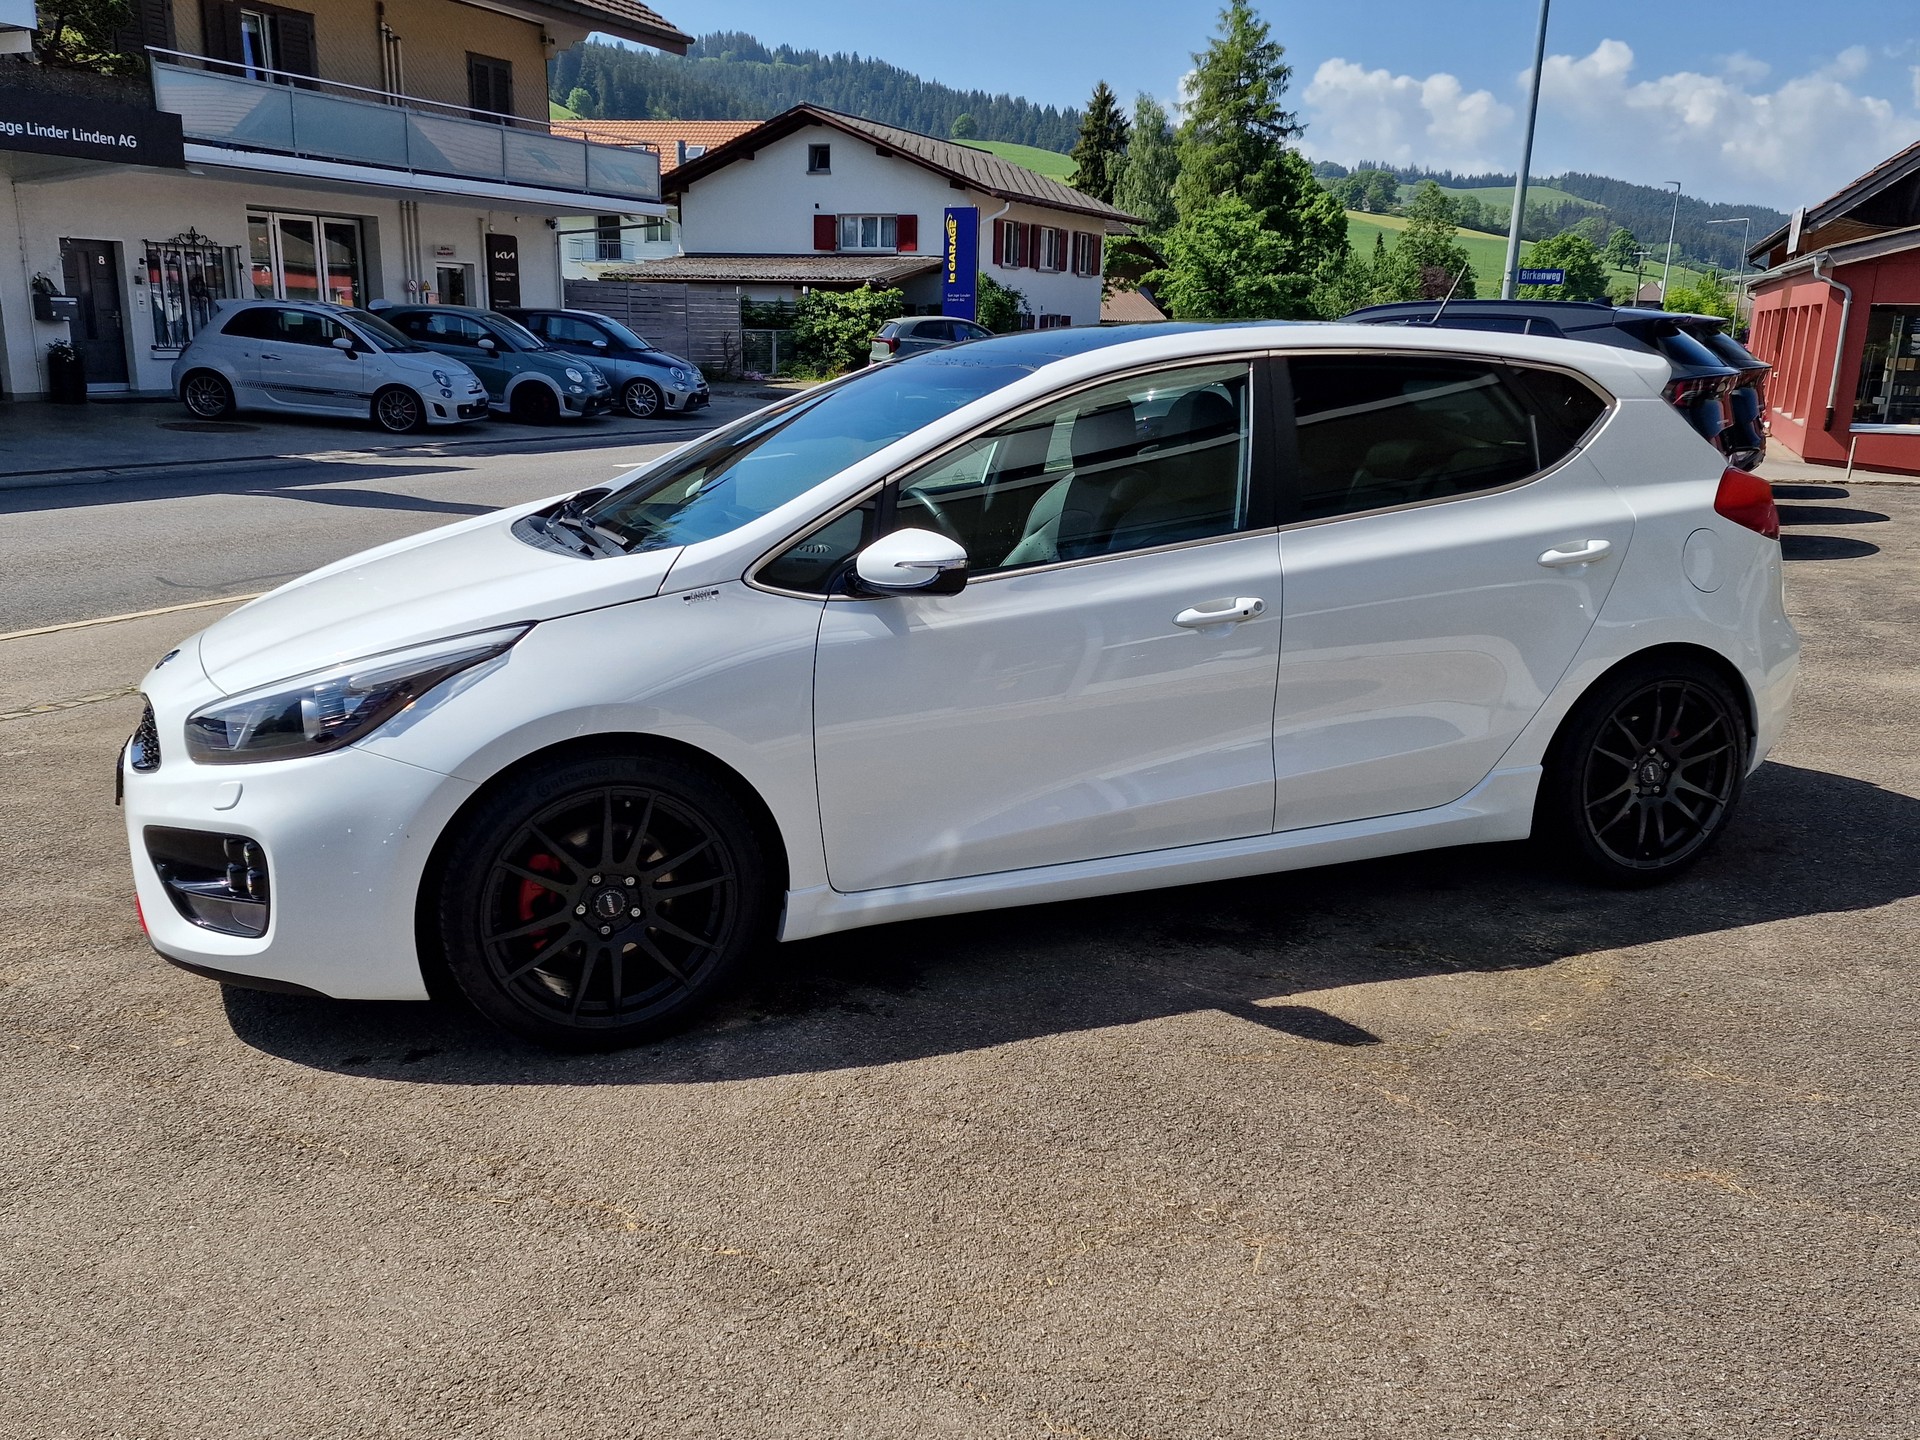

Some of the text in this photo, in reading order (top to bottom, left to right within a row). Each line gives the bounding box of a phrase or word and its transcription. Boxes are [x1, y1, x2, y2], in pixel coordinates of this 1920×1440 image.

[26, 121, 70, 140] Linder
[72, 127, 116, 146] Linden
[118, 134, 138, 148] AG
[948, 219, 957, 271] GARAGE
[98, 255, 106, 265] 8
[1521, 270, 1561, 282] Birkenweg
